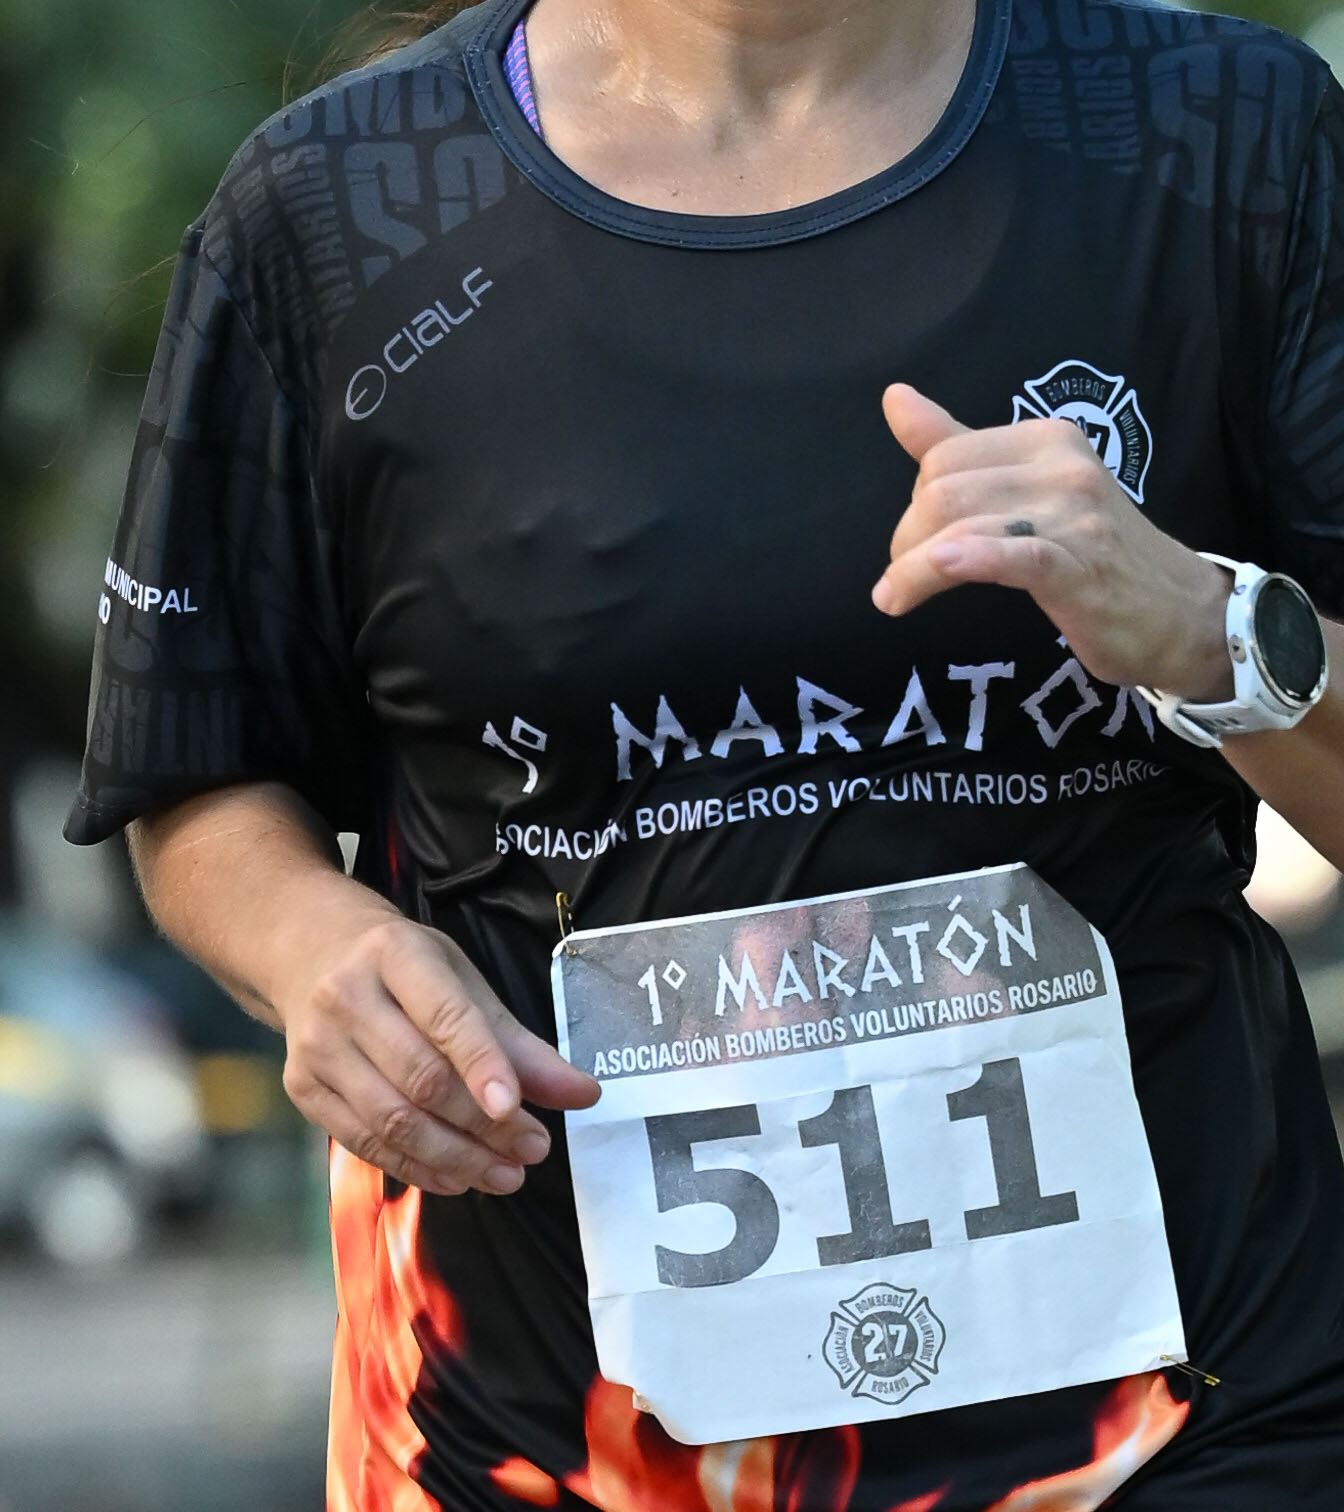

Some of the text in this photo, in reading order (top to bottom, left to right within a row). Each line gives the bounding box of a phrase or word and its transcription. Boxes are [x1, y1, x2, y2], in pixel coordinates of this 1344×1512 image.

[636, 782, 819, 839] BOMBEROS
[828, 771, 1049, 808] VOLUNTARIOS
[715, 895, 1038, 1016] MARATÓN
[593, 967, 1099, 1077] ASOCIACIÓN BOMBEROS VOLUNTARIOS ROSARIO
[643, 1057, 1081, 1288] 511
[855, 1293, 905, 1314] BOMBEROS
[861, 1321, 908, 1363] 27
